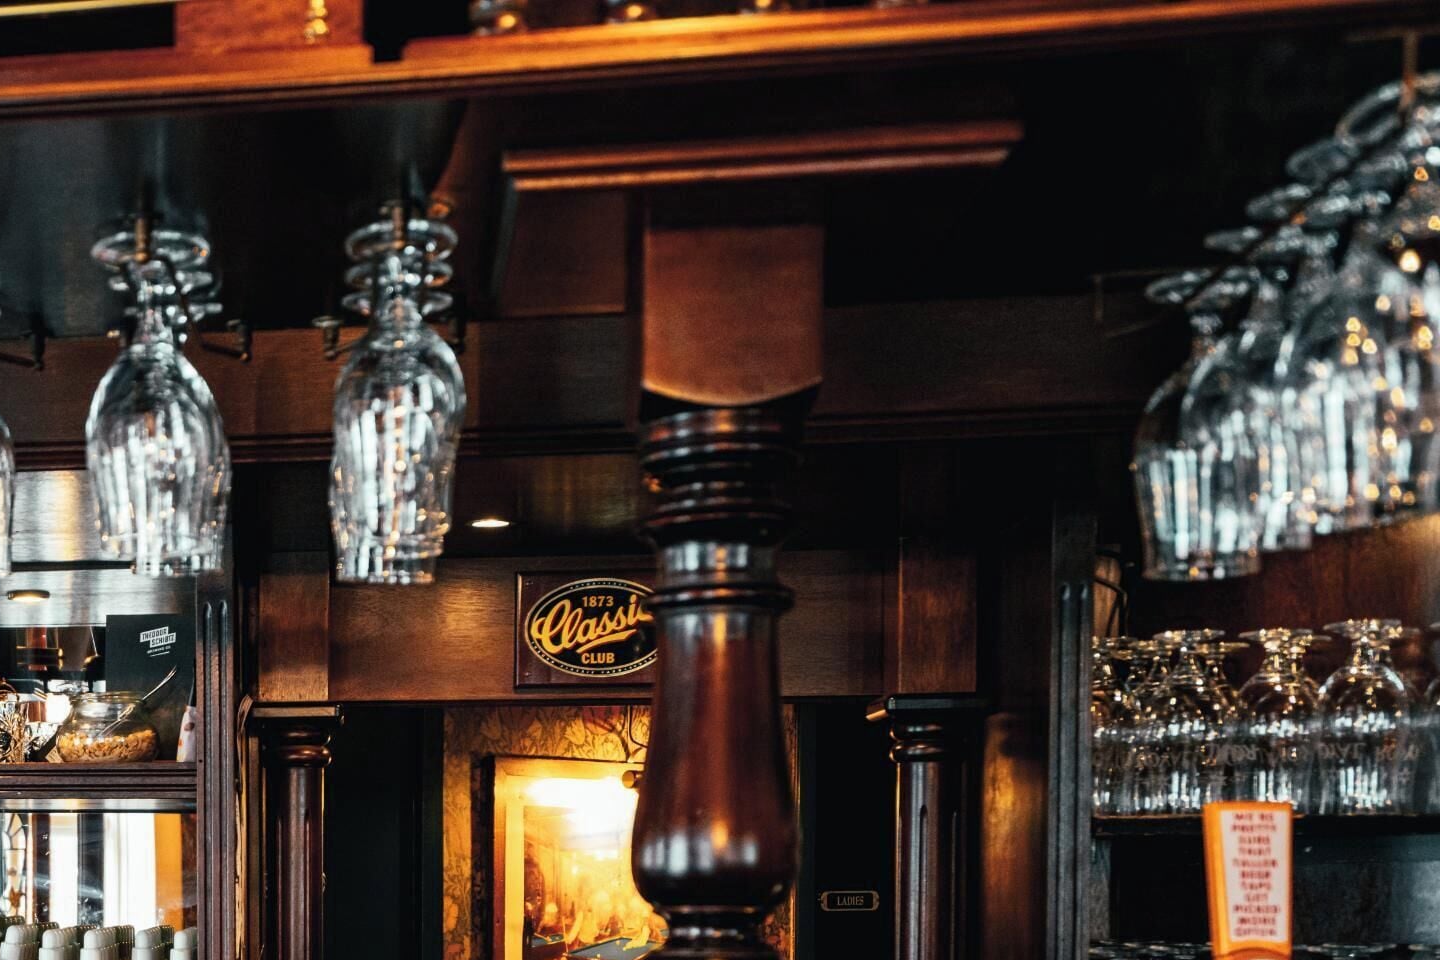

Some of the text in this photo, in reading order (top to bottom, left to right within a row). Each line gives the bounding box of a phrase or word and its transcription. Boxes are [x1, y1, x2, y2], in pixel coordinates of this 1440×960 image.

[582, 596, 614, 607] 1873
[581, 652, 615, 664] CLUB
[837, 895, 865, 906] LADIES
